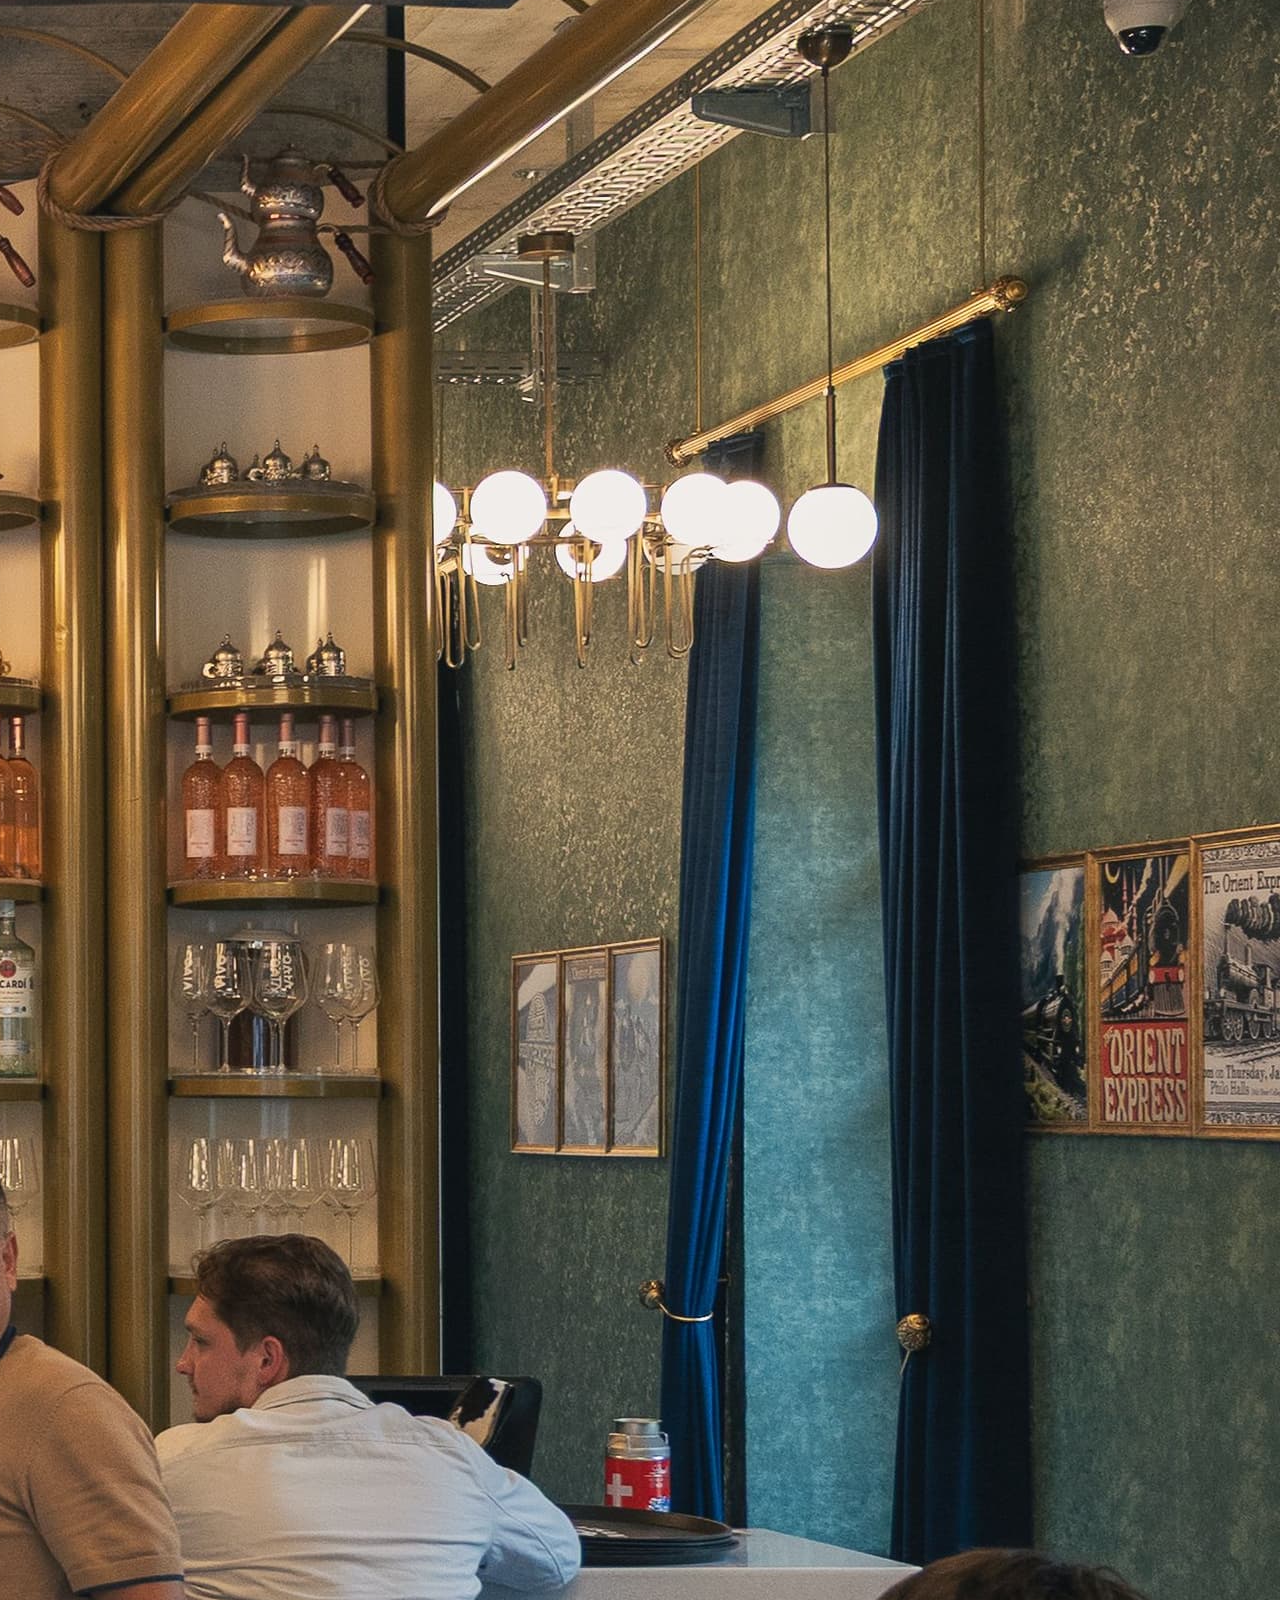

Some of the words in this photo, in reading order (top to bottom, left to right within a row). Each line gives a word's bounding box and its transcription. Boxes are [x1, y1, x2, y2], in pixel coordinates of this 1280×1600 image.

[1203, 875, 1221, 895] The
[1222, 872, 1254, 893] Orient
[1109, 1026, 1185, 1076] ORIENT
[1225, 1064, 1269, 1083] Thursday,
[1103, 1077, 1187, 1122] EXPRESS
